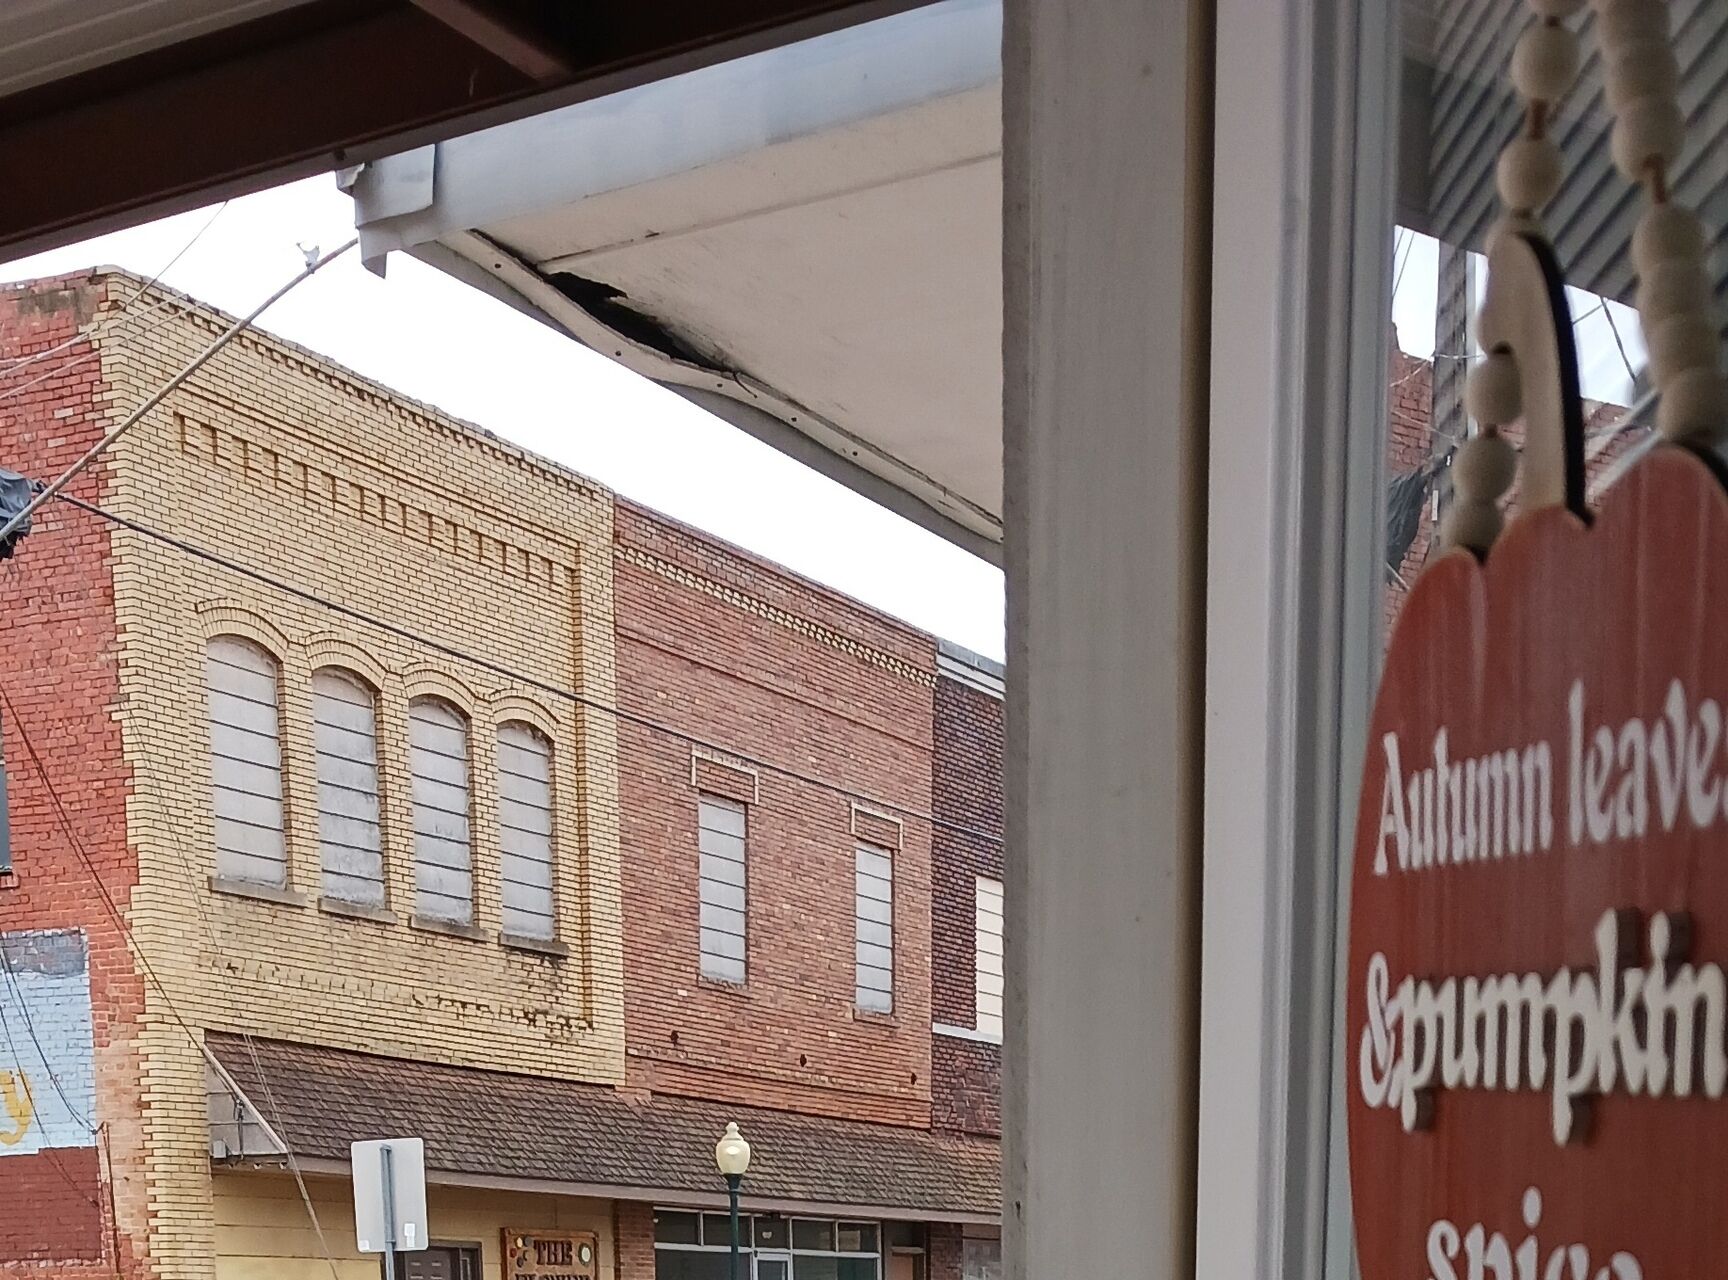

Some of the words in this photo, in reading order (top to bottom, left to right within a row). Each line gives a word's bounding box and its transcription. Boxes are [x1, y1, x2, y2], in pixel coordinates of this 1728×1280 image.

[1373, 726, 1555, 876] Autumn
[1567, 678, 1728, 846] leave
[533, 1240, 573, 1266] THE
